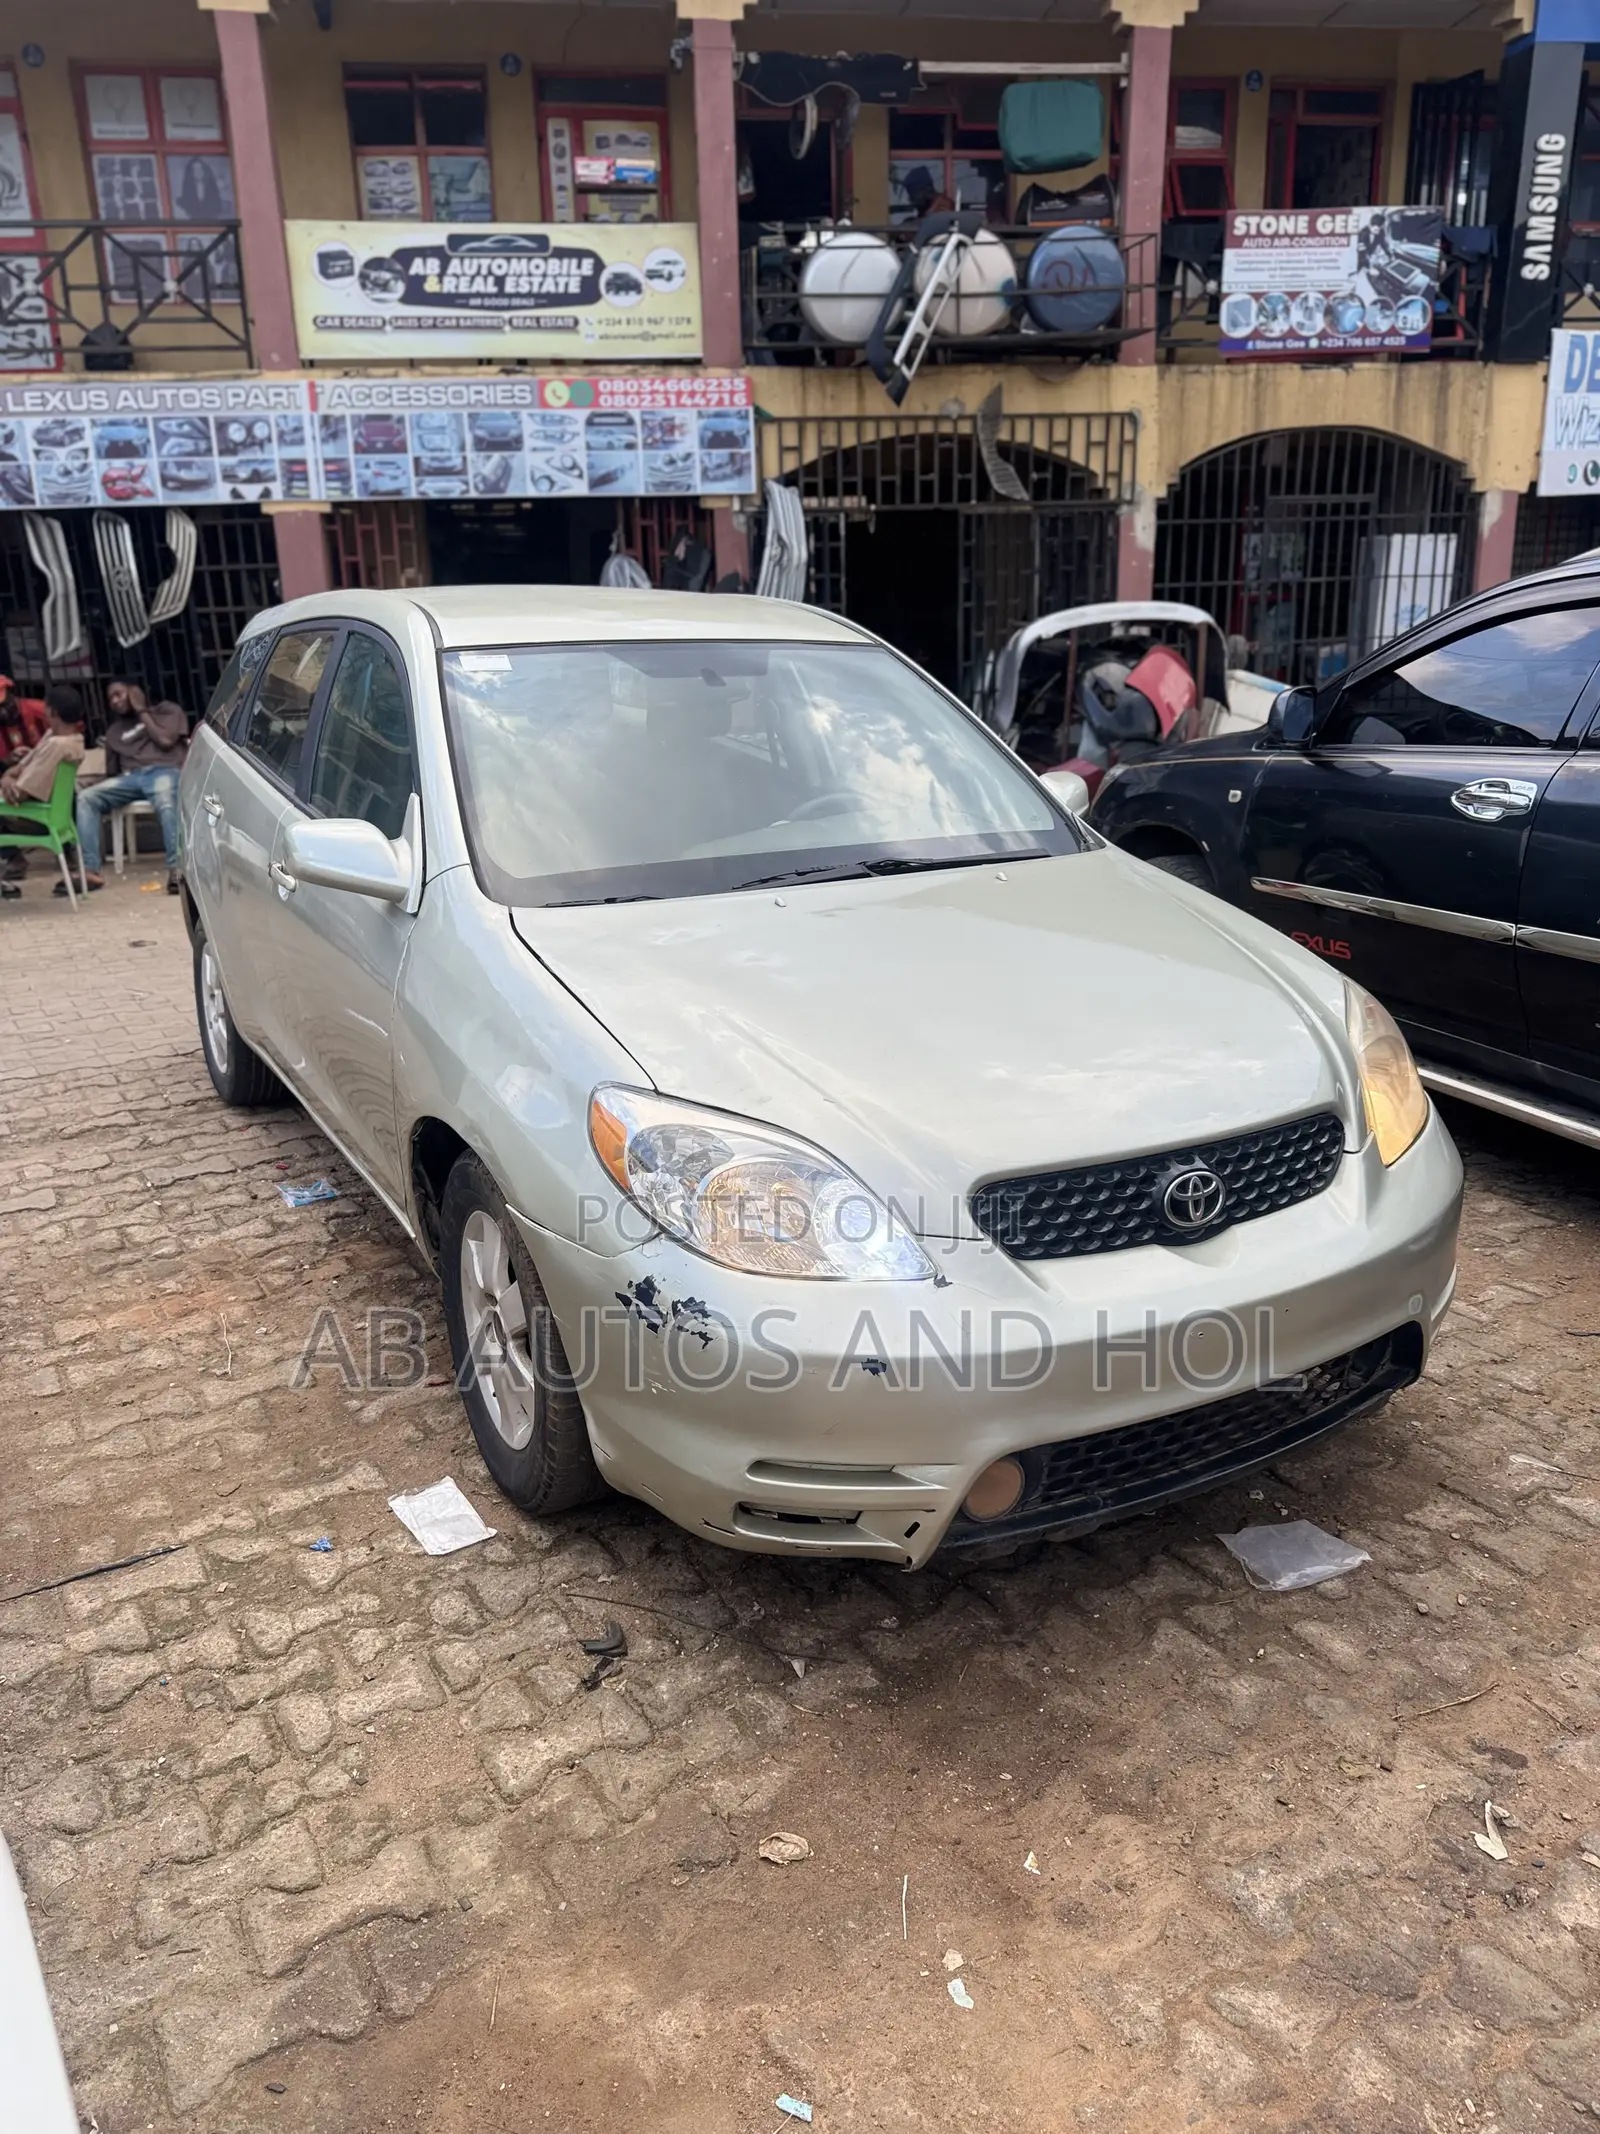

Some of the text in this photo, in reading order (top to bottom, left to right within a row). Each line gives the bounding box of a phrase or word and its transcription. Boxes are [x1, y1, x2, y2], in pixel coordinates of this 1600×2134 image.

[1520, 133, 1566, 281] SAMSUNG
[1232, 213, 1360, 236] STONE GEE
[1242, 236, 1348, 248] AUTO AIR-CONDITION
[408, 257, 595, 277] AB AUTOMOBILE
[423, 275, 582, 294] &REAL ESTATE
[315, 316, 384, 328] CAR DEALER
[436, 317, 457, 328] CAR
[511, 316, 575, 328] REAL ESTATE
[5, 389, 109, 413] LEXUS
[115, 387, 222, 411] AUTOS
[329, 384, 533, 409] ACCESSORIES
[1290, 931, 1352, 960] EXUS
